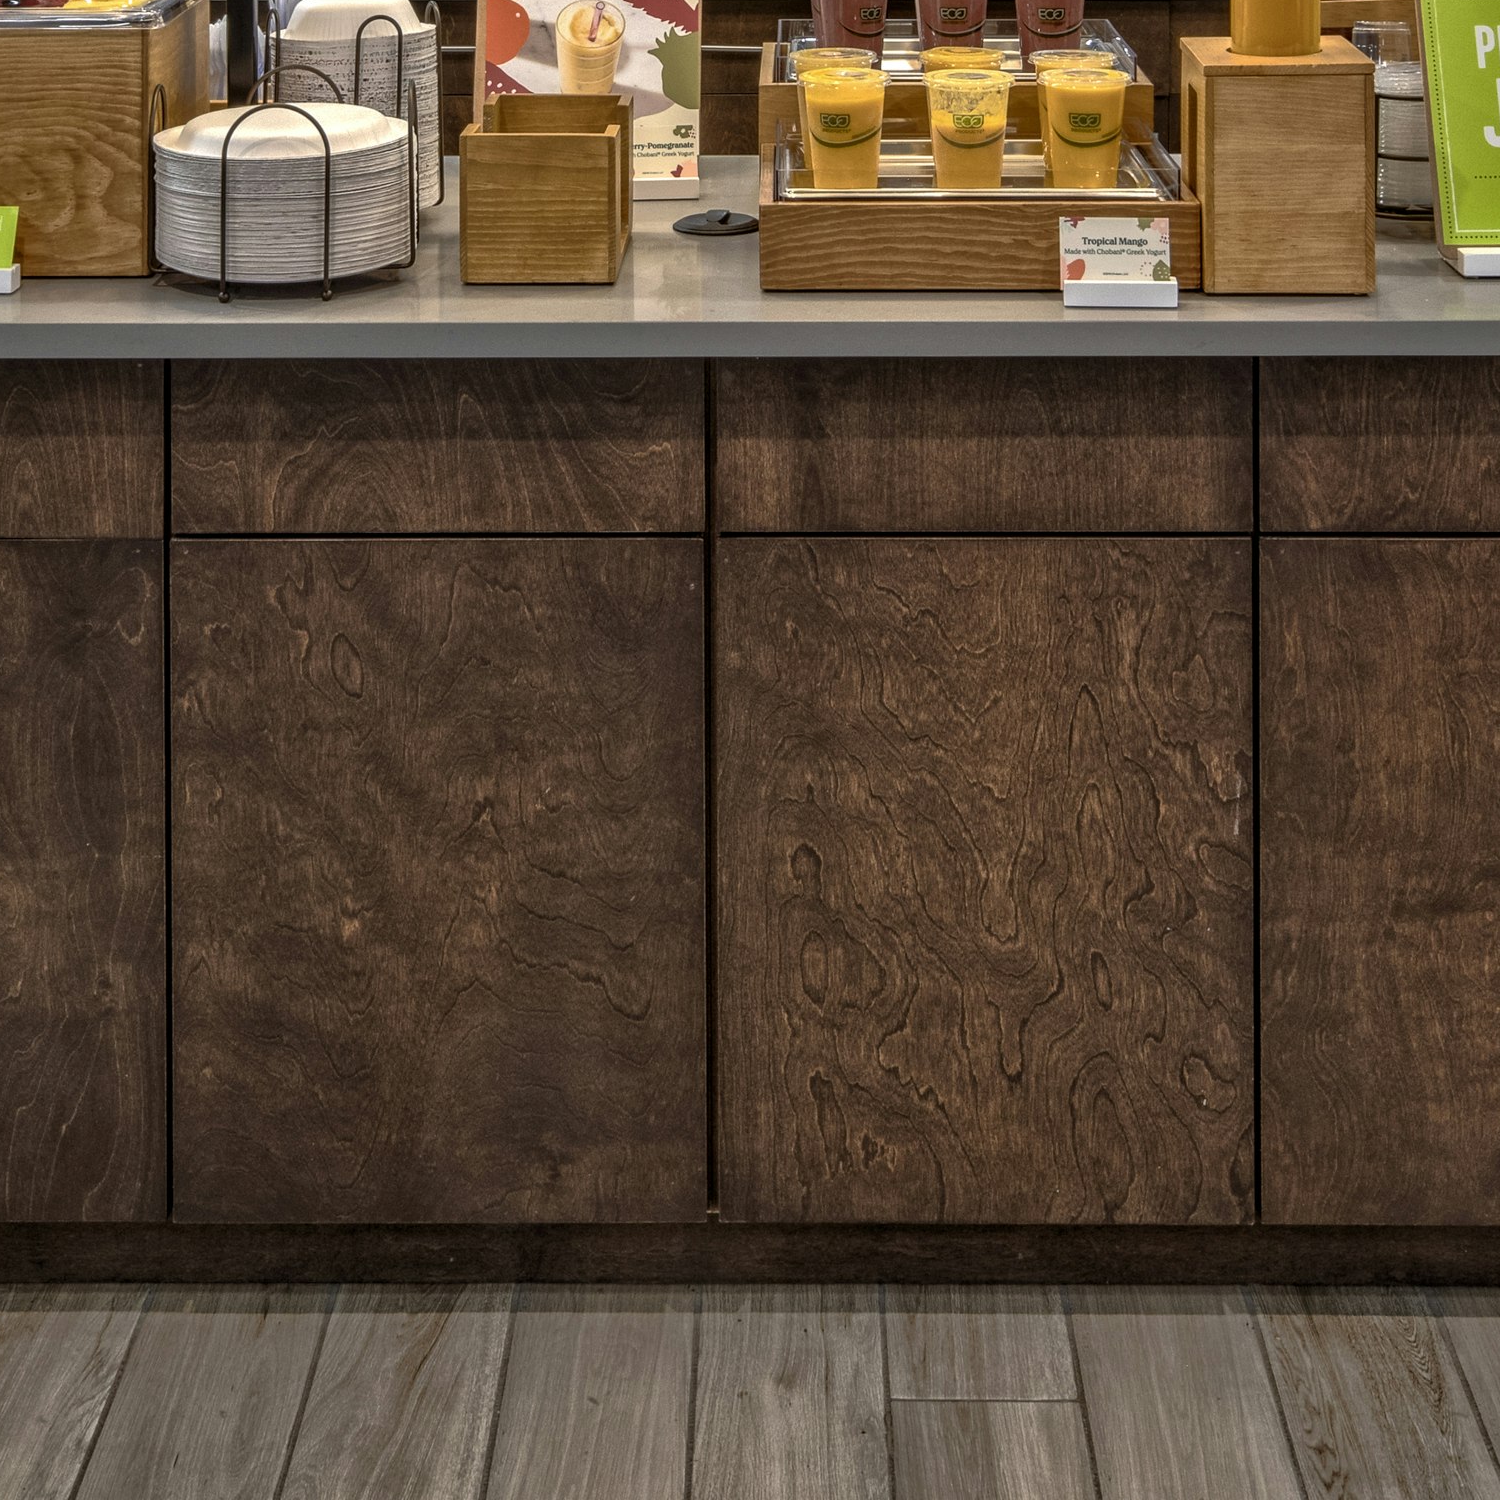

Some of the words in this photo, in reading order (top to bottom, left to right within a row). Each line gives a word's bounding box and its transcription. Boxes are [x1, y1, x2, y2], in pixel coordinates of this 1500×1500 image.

[1082, 237, 1117, 246] Tropical
[1119, 238, 1148, 247] Mango
[1146, 248, 1167, 256] Yogurt
